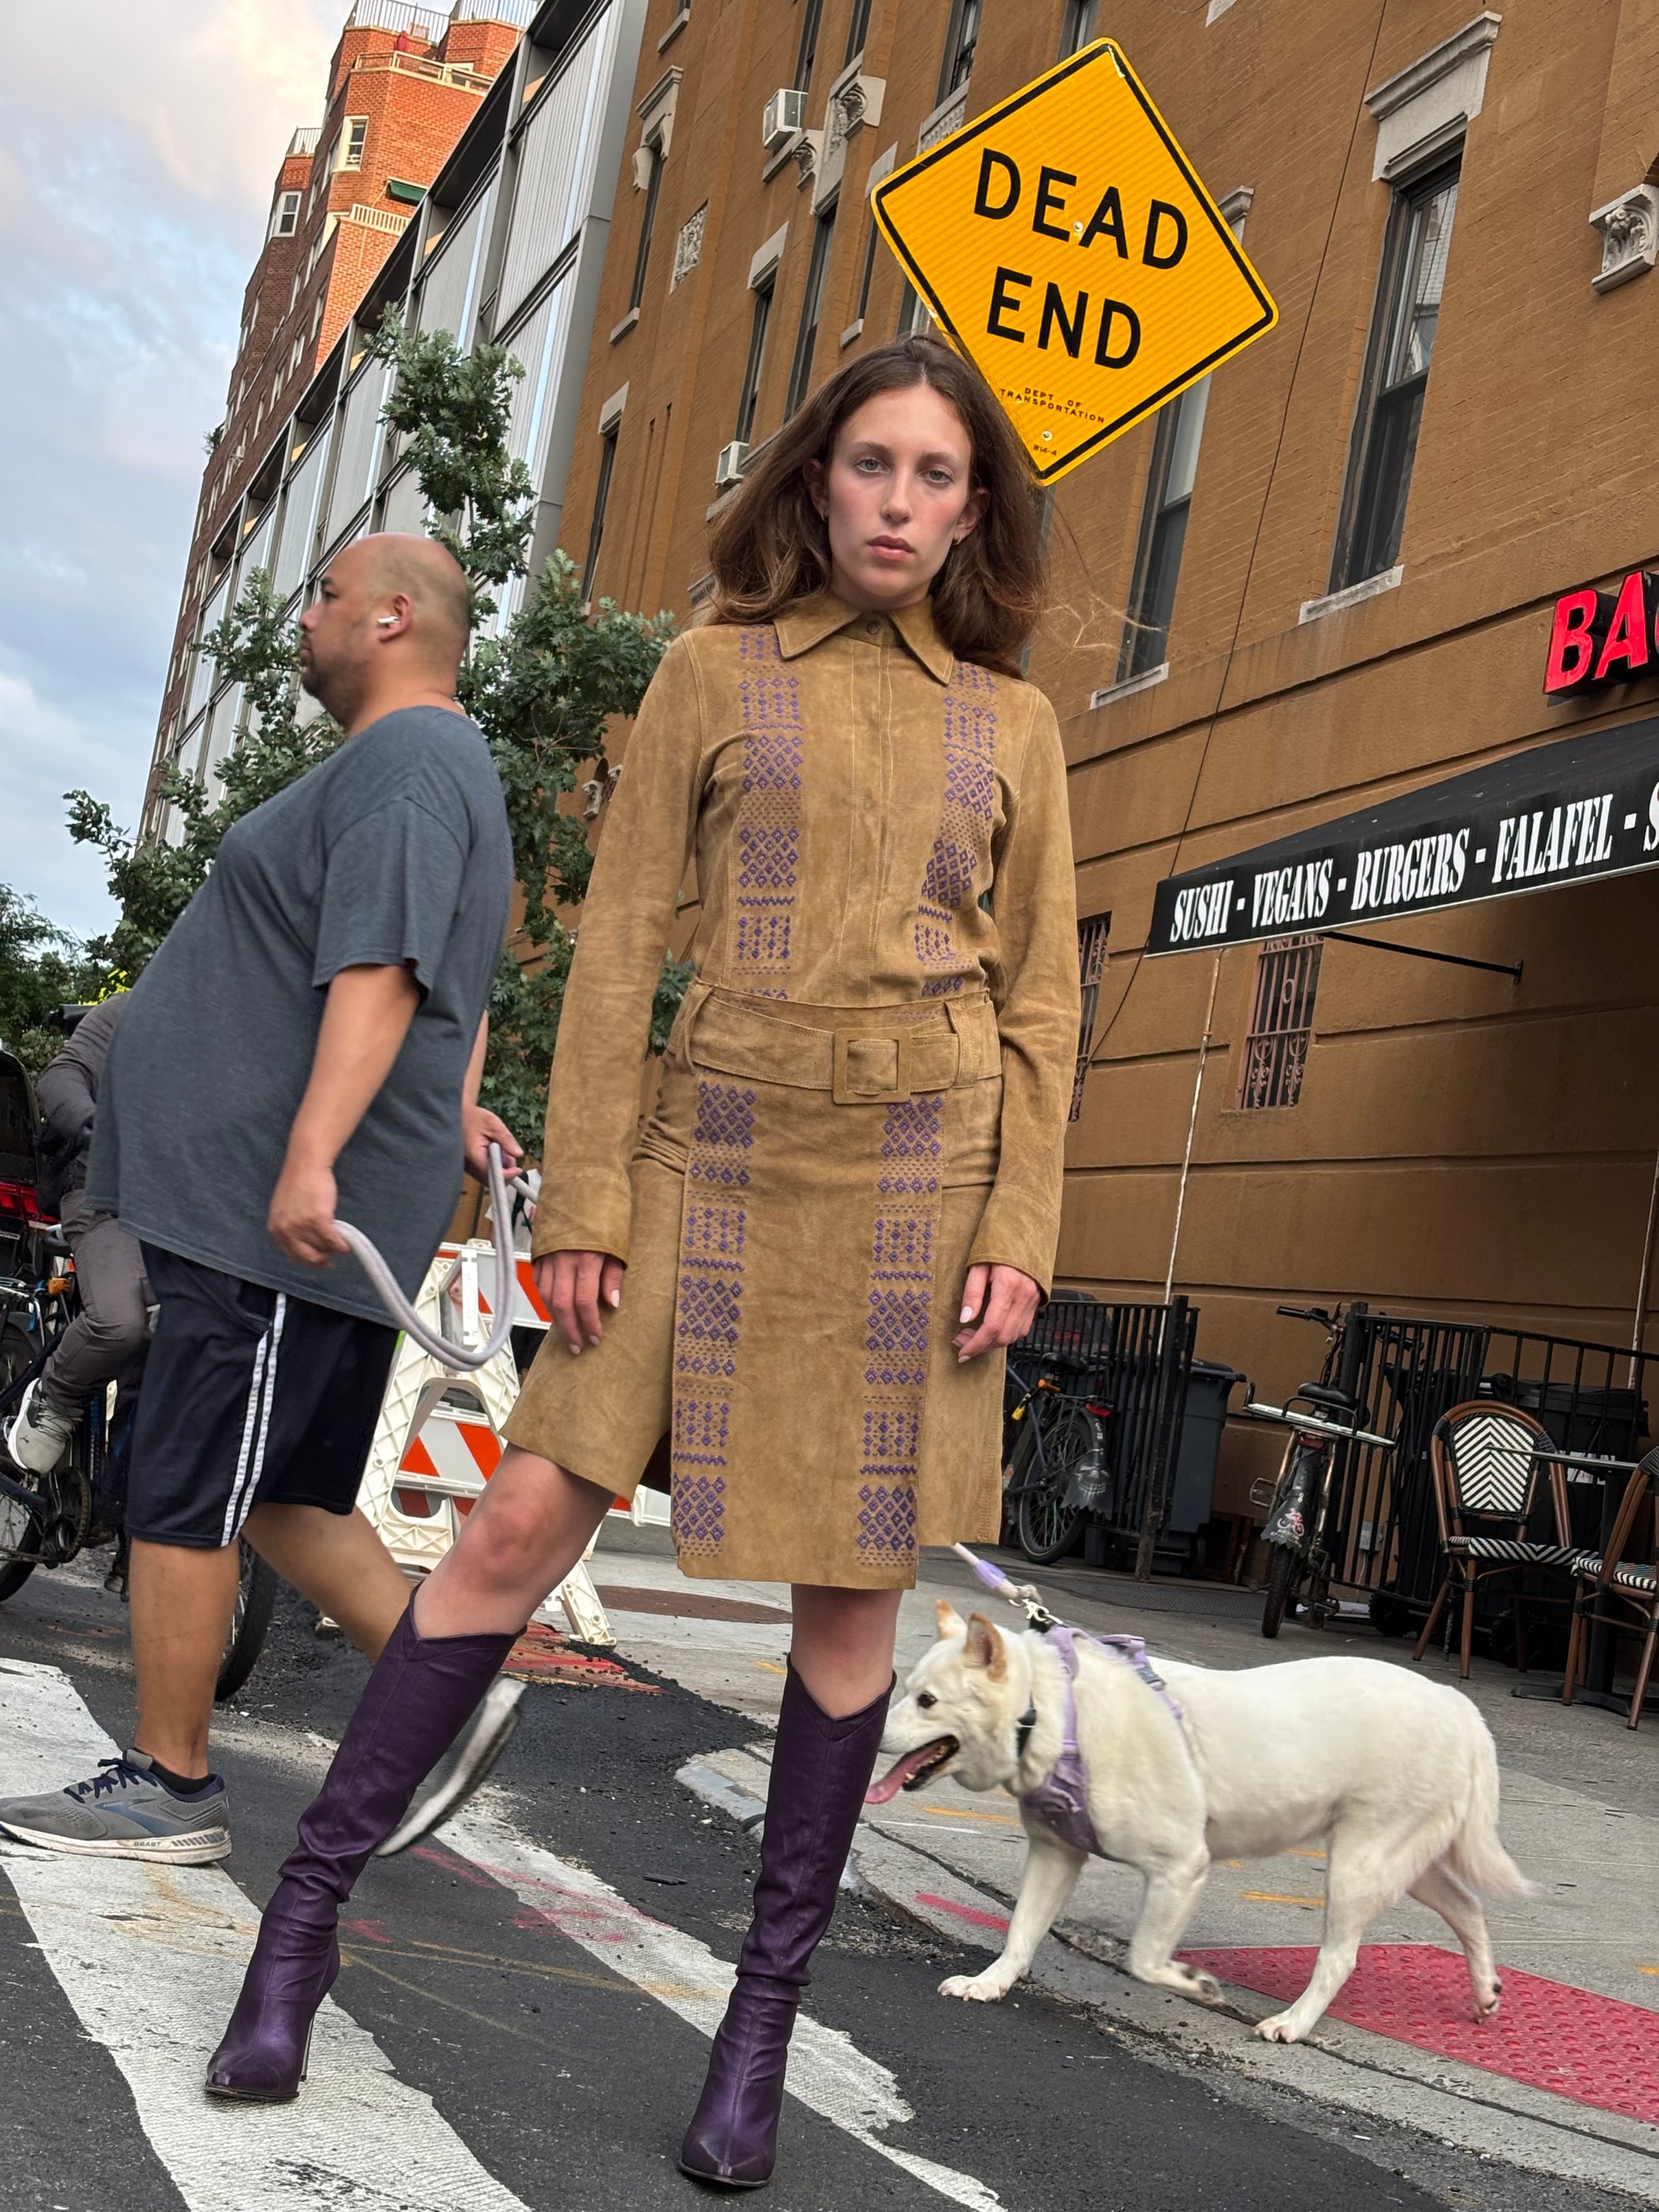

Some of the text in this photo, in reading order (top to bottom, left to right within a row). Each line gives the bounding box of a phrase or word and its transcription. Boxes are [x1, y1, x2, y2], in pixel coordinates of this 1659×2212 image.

[974, 148, 1188, 270] DEAD
[986, 266, 1141, 369] END
[1000, 388, 1105, 423] TRANSPORTATION
[1024, 387, 1082, 408] DEPT OF
[1544, 570, 1659, 695] BA
[1170, 880, 1234, 942] SUSHI
[1252, 858, 1334, 927] VEGANS
[1350, 827, 1470, 910] BURGERS
[1491, 794, 1613, 883] FALAFEL
